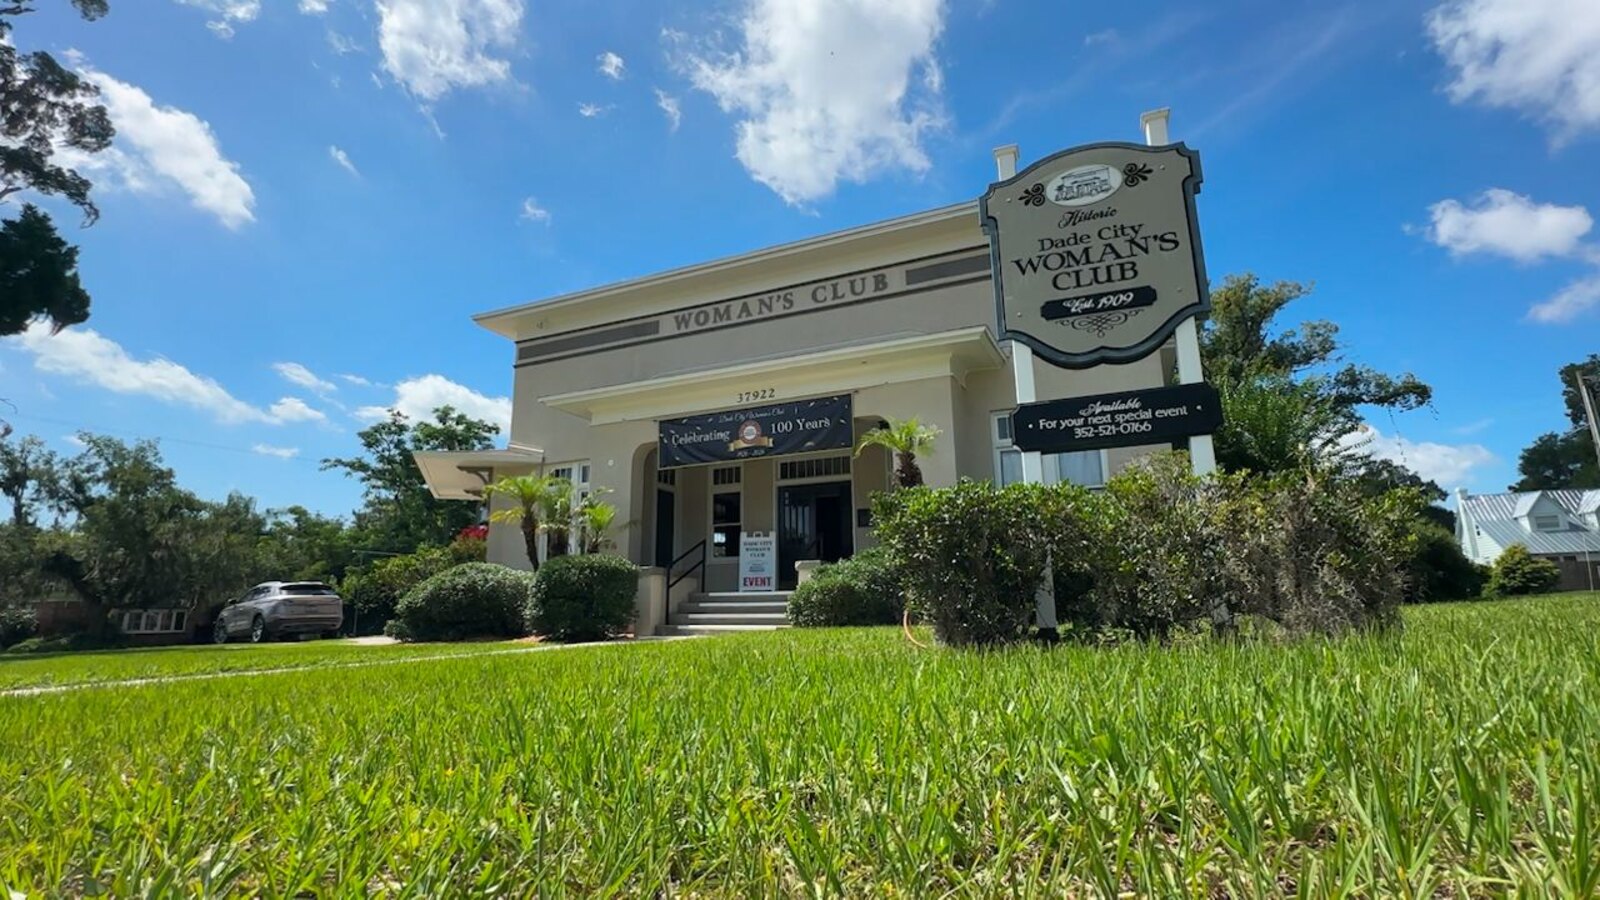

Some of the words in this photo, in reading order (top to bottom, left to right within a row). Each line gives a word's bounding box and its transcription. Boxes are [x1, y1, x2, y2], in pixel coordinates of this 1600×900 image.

[1058, 206, 1117, 229] Historic
[1038, 232, 1091, 252] Dade
[1097, 223, 1144, 242] City
[1011, 231, 1180, 277] WOMAN'S
[1052, 261, 1139, 291] CLUB
[673, 291, 795, 332] WOMAN'S
[811, 273, 889, 304] CLUB
[1062, 299, 1095, 313] Est.
[1097, 291, 1135, 309] 1909
[736, 388, 776, 404] 37922
[1039, 418, 1058, 430] For
[1059, 416, 1086, 430] your
[1087, 412, 1112, 424] next
[1114, 408, 1153, 423] special
[1155, 405, 1189, 417] event
[1079, 398, 1142, 417] Available
[770, 420, 793, 435] 100
[796, 417, 832, 431] Years
[1073, 421, 1152, 439] 352-521-0766
[671, 429, 731, 448] Celebrating
[743, 576, 772, 587] EVENT
